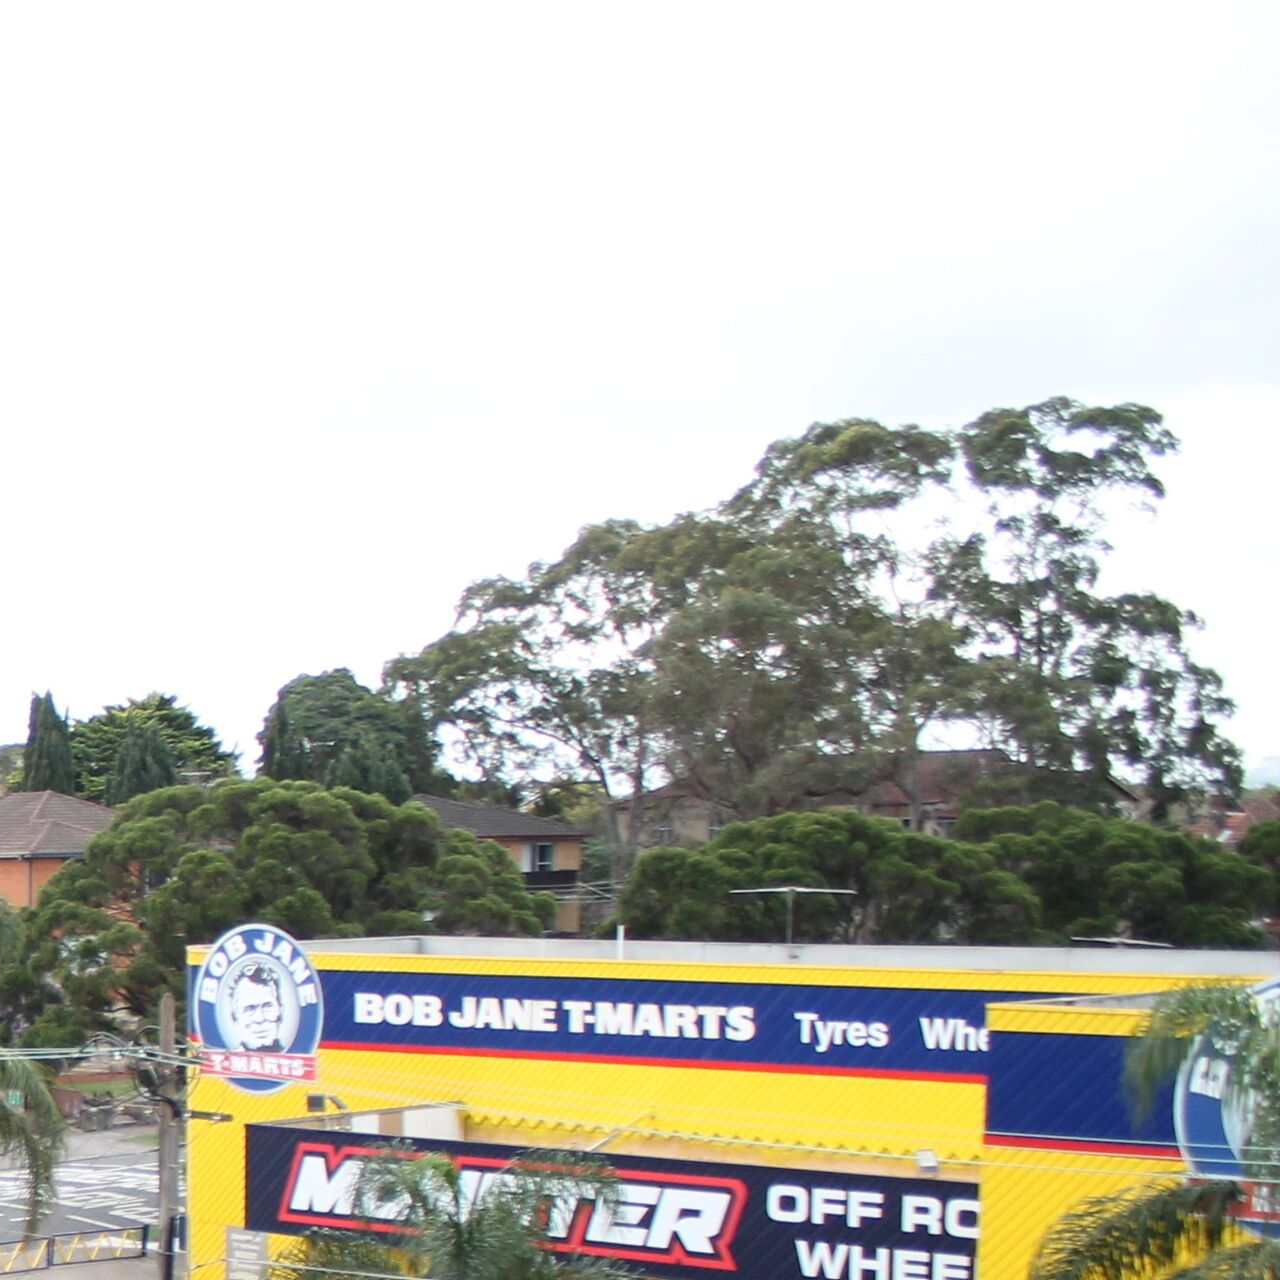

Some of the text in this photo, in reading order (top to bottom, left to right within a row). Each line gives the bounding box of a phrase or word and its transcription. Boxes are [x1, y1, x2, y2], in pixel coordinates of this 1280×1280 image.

[201, 930, 318, 1008] BOB JANE
[353, 992, 444, 1028] BOB
[448, 996, 558, 1033] JANE
[561, 1001, 756, 1042] T-MARTS
[793, 1011, 889, 1053] Tyres
[211, 1056, 306, 1079] T-MARTS
[766, 1184, 885, 1230] OFF
